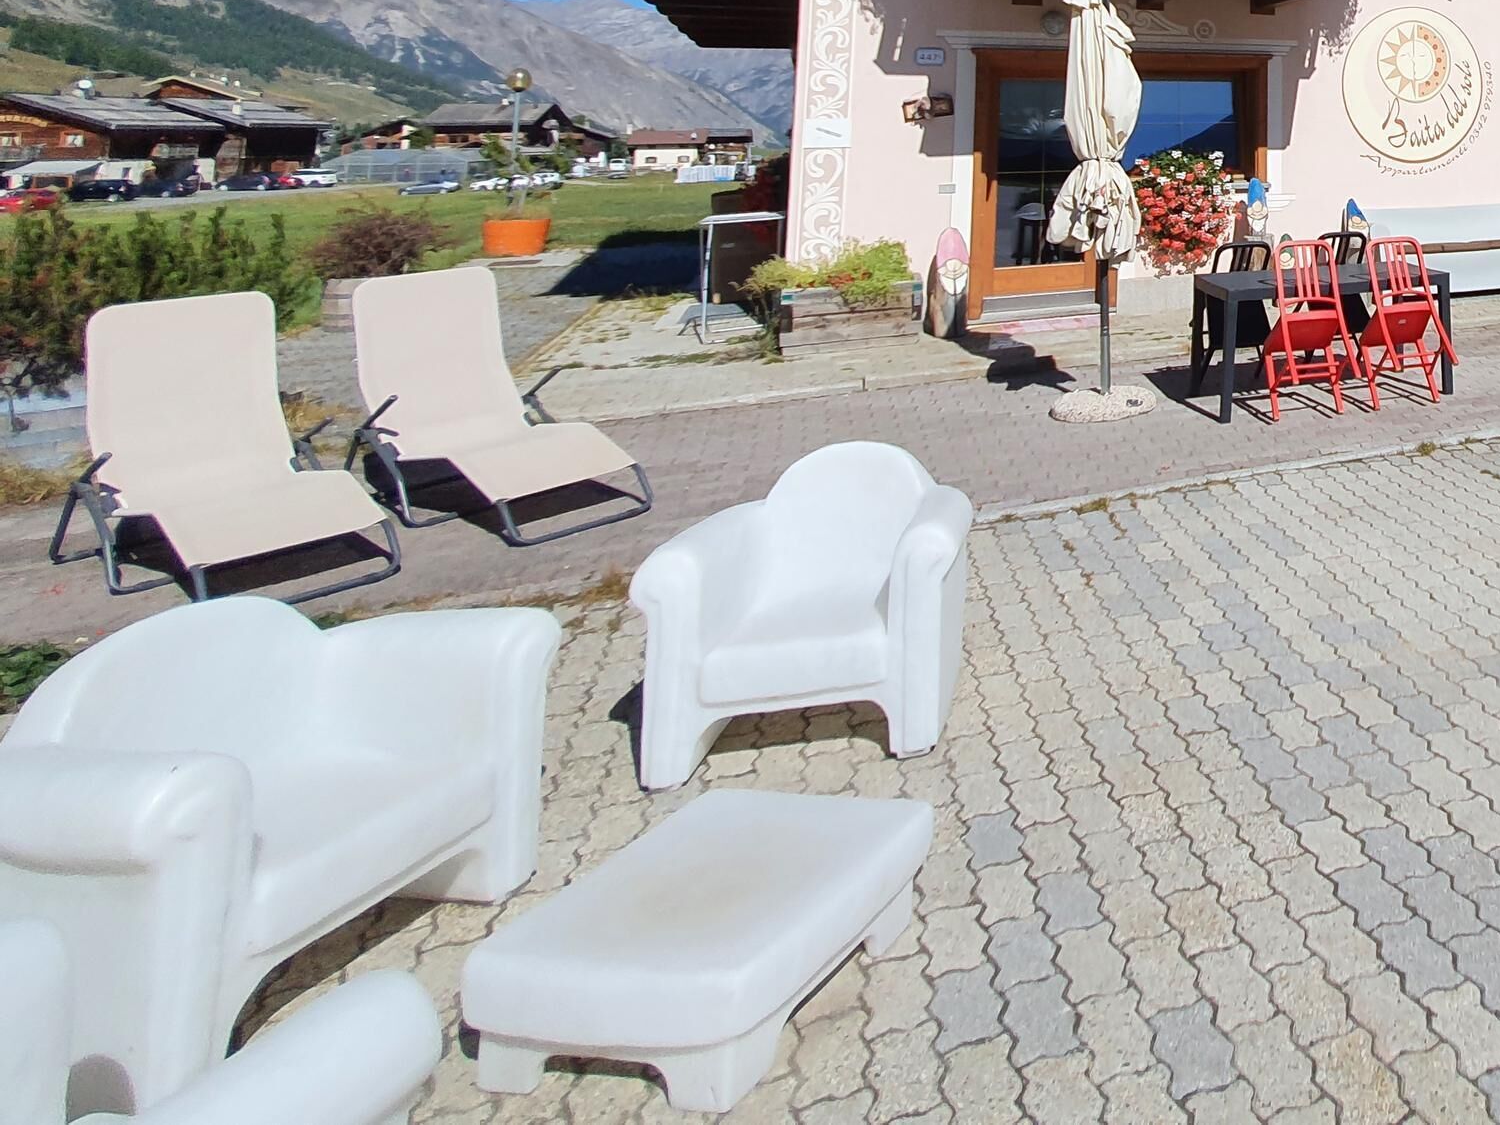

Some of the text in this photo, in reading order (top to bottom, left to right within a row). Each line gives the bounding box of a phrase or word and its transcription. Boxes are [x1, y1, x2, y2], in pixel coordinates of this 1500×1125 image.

[1382, 60, 1472, 148] Baita del sole
[1468, 114, 1488, 144] 0342
